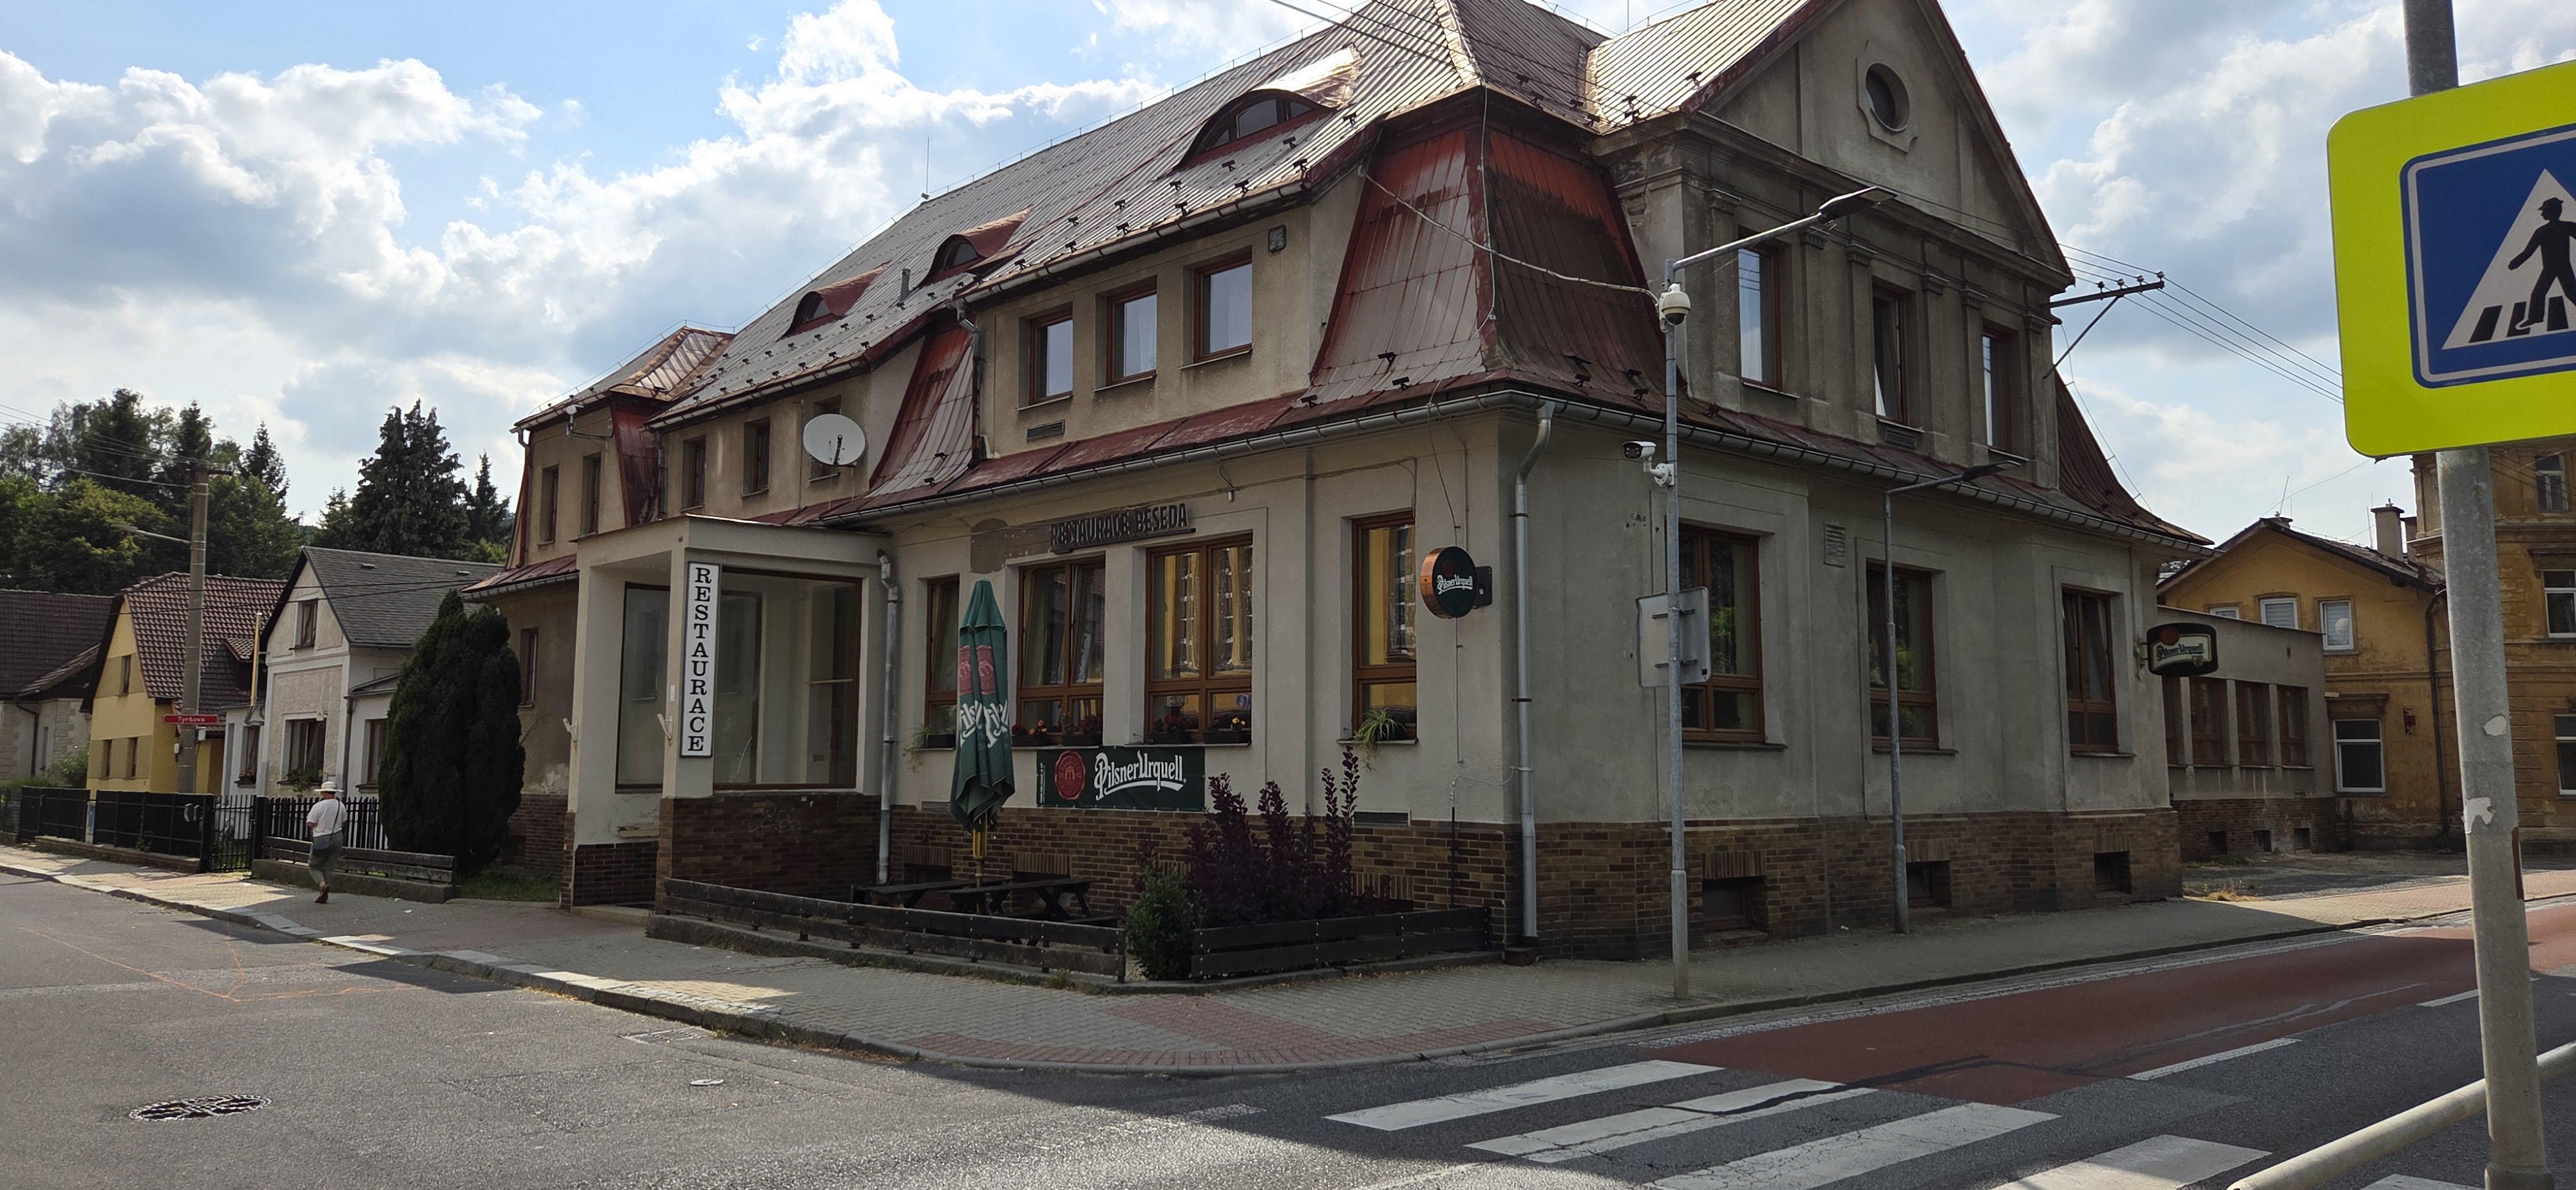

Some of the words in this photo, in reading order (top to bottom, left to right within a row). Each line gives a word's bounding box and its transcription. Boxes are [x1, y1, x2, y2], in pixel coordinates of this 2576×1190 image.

[1051, 511, 1130, 546] RESTAURACE
[1135, 503, 1188, 533] BESEDA
[687, 567, 712, 752] RESTAURACE
[1094, 751, 1139, 801] Pilsner
[1136, 749, 1183, 793] Urquell
